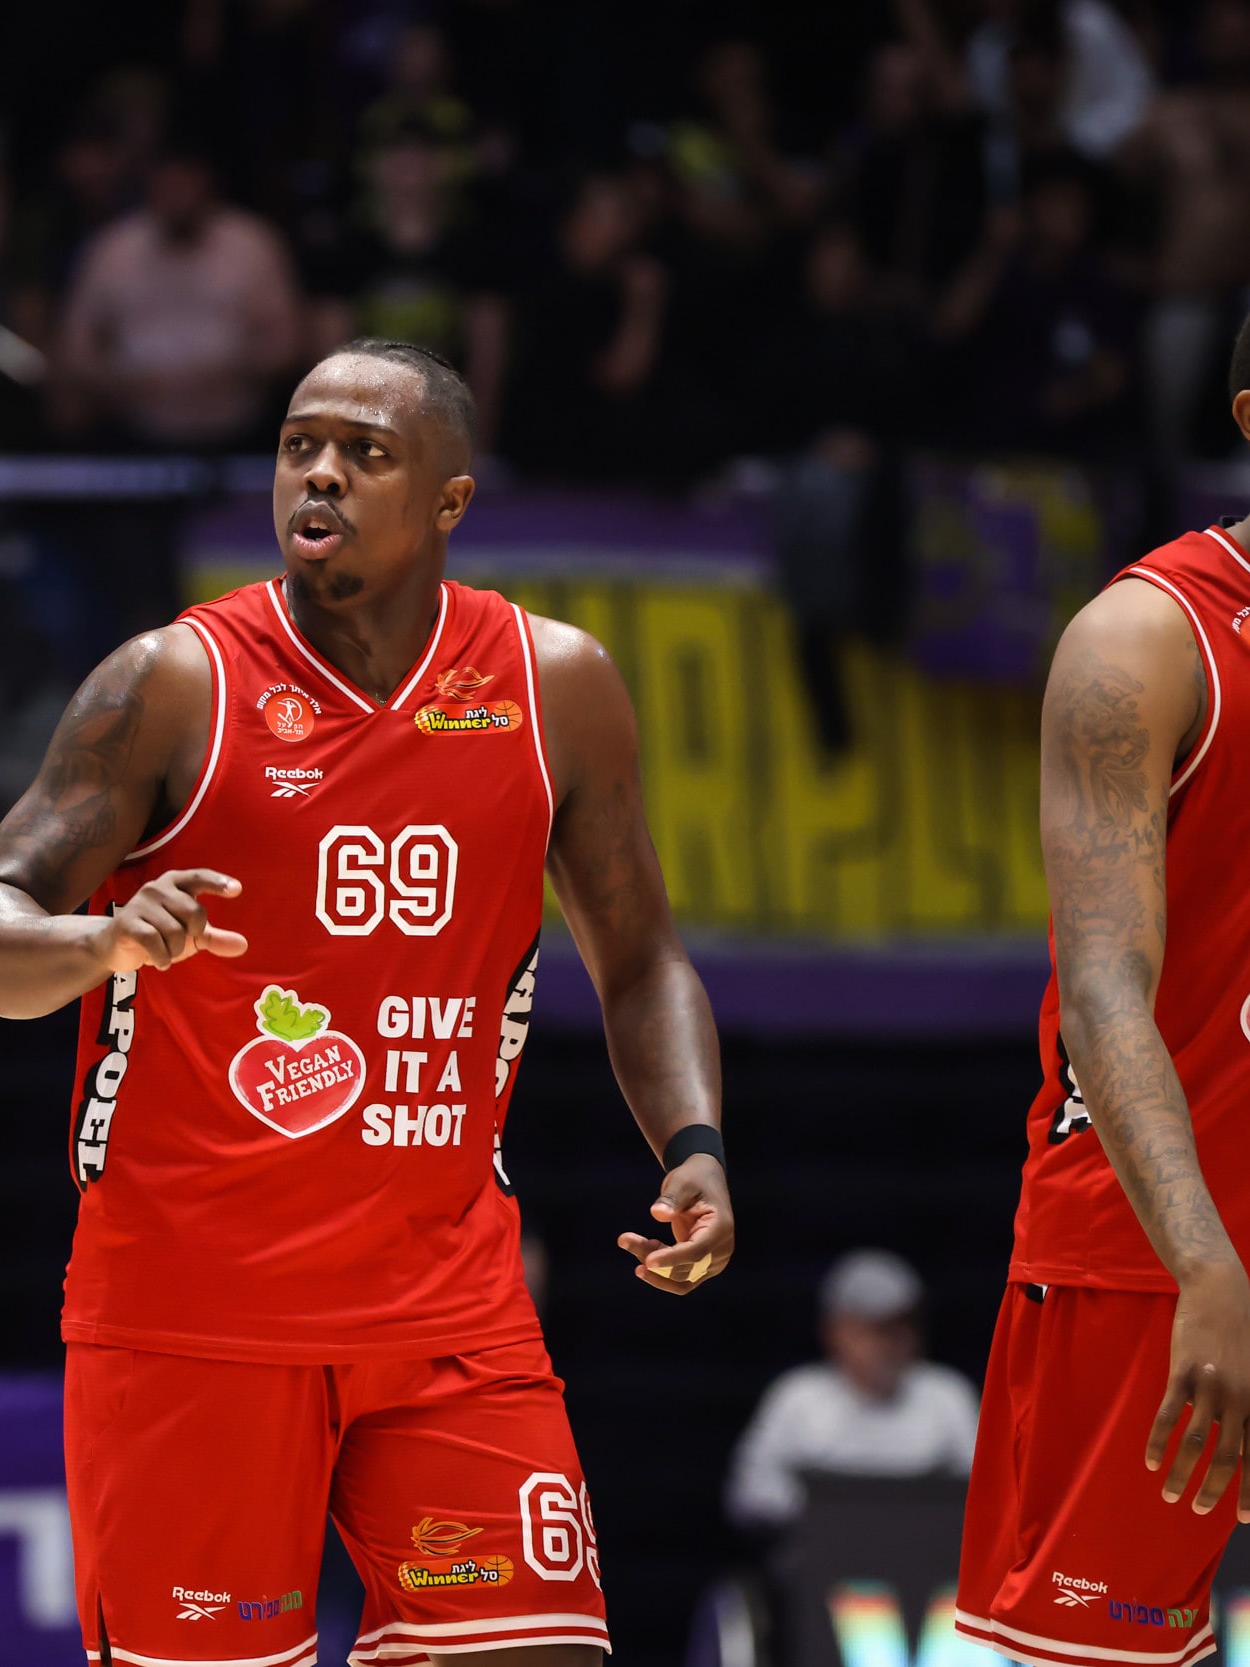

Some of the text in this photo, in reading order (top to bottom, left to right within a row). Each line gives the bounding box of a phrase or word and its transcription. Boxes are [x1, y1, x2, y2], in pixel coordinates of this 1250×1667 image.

[429, 713, 491, 730] Winner
[491, 713, 509, 727] סל
[265, 766, 324, 781] Reebok
[315, 825, 459, 937] 69
[377, 996, 476, 1040] GIVE
[385, 1050, 462, 1094] IT A
[361, 1103, 467, 1148] SHOT
[451, 1560, 476, 1574] ליגת
[480, 1567, 499, 1582] סל
[409, 1569, 479, 1587] Winner
[1052, 1571, 1108, 1594] Reebok
[172, 1586, 231, 1603] Reebok
